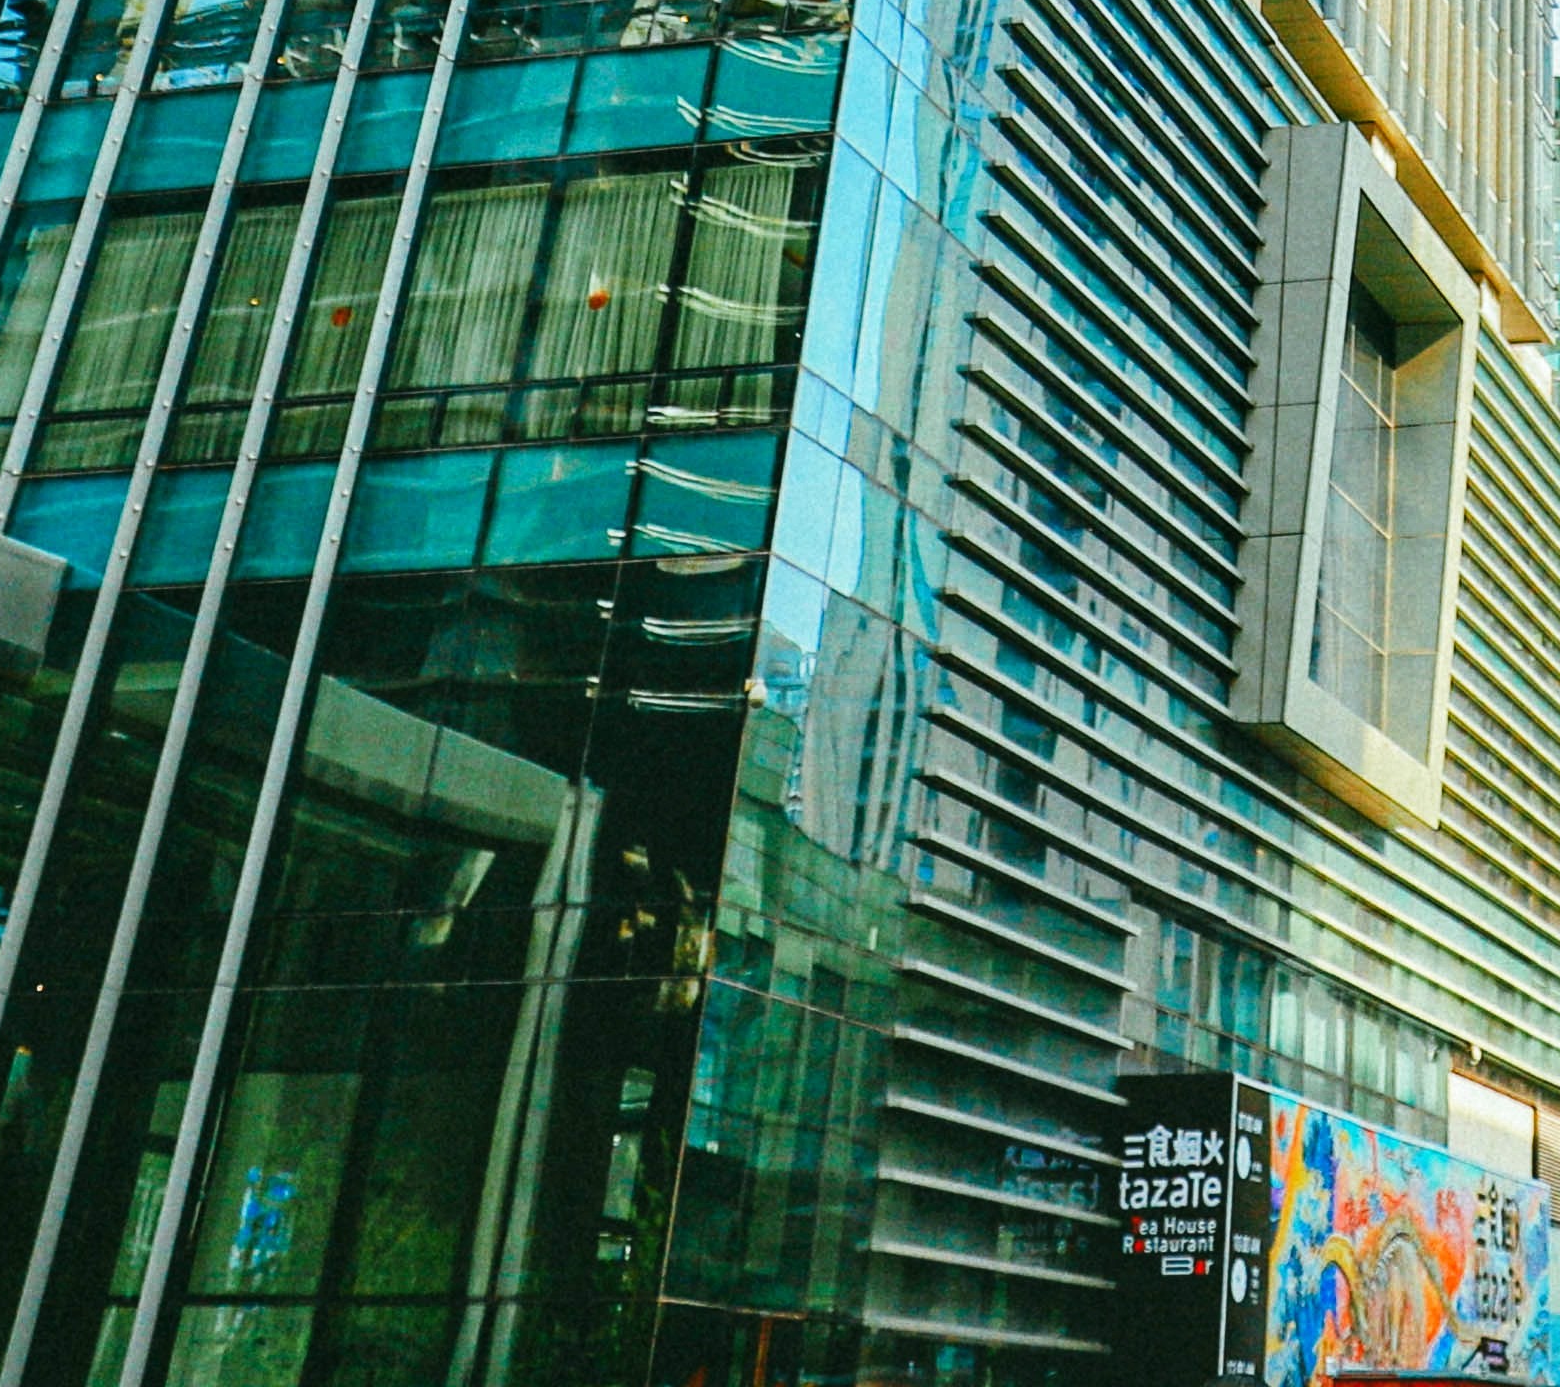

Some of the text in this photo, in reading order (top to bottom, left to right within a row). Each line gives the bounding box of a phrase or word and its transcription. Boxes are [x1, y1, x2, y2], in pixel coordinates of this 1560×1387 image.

[1119, 1171, 1223, 1210] tazaTe
[1131, 1216, 1217, 1236] Tea House
[1122, 1235, 1215, 1254] Restaurant
